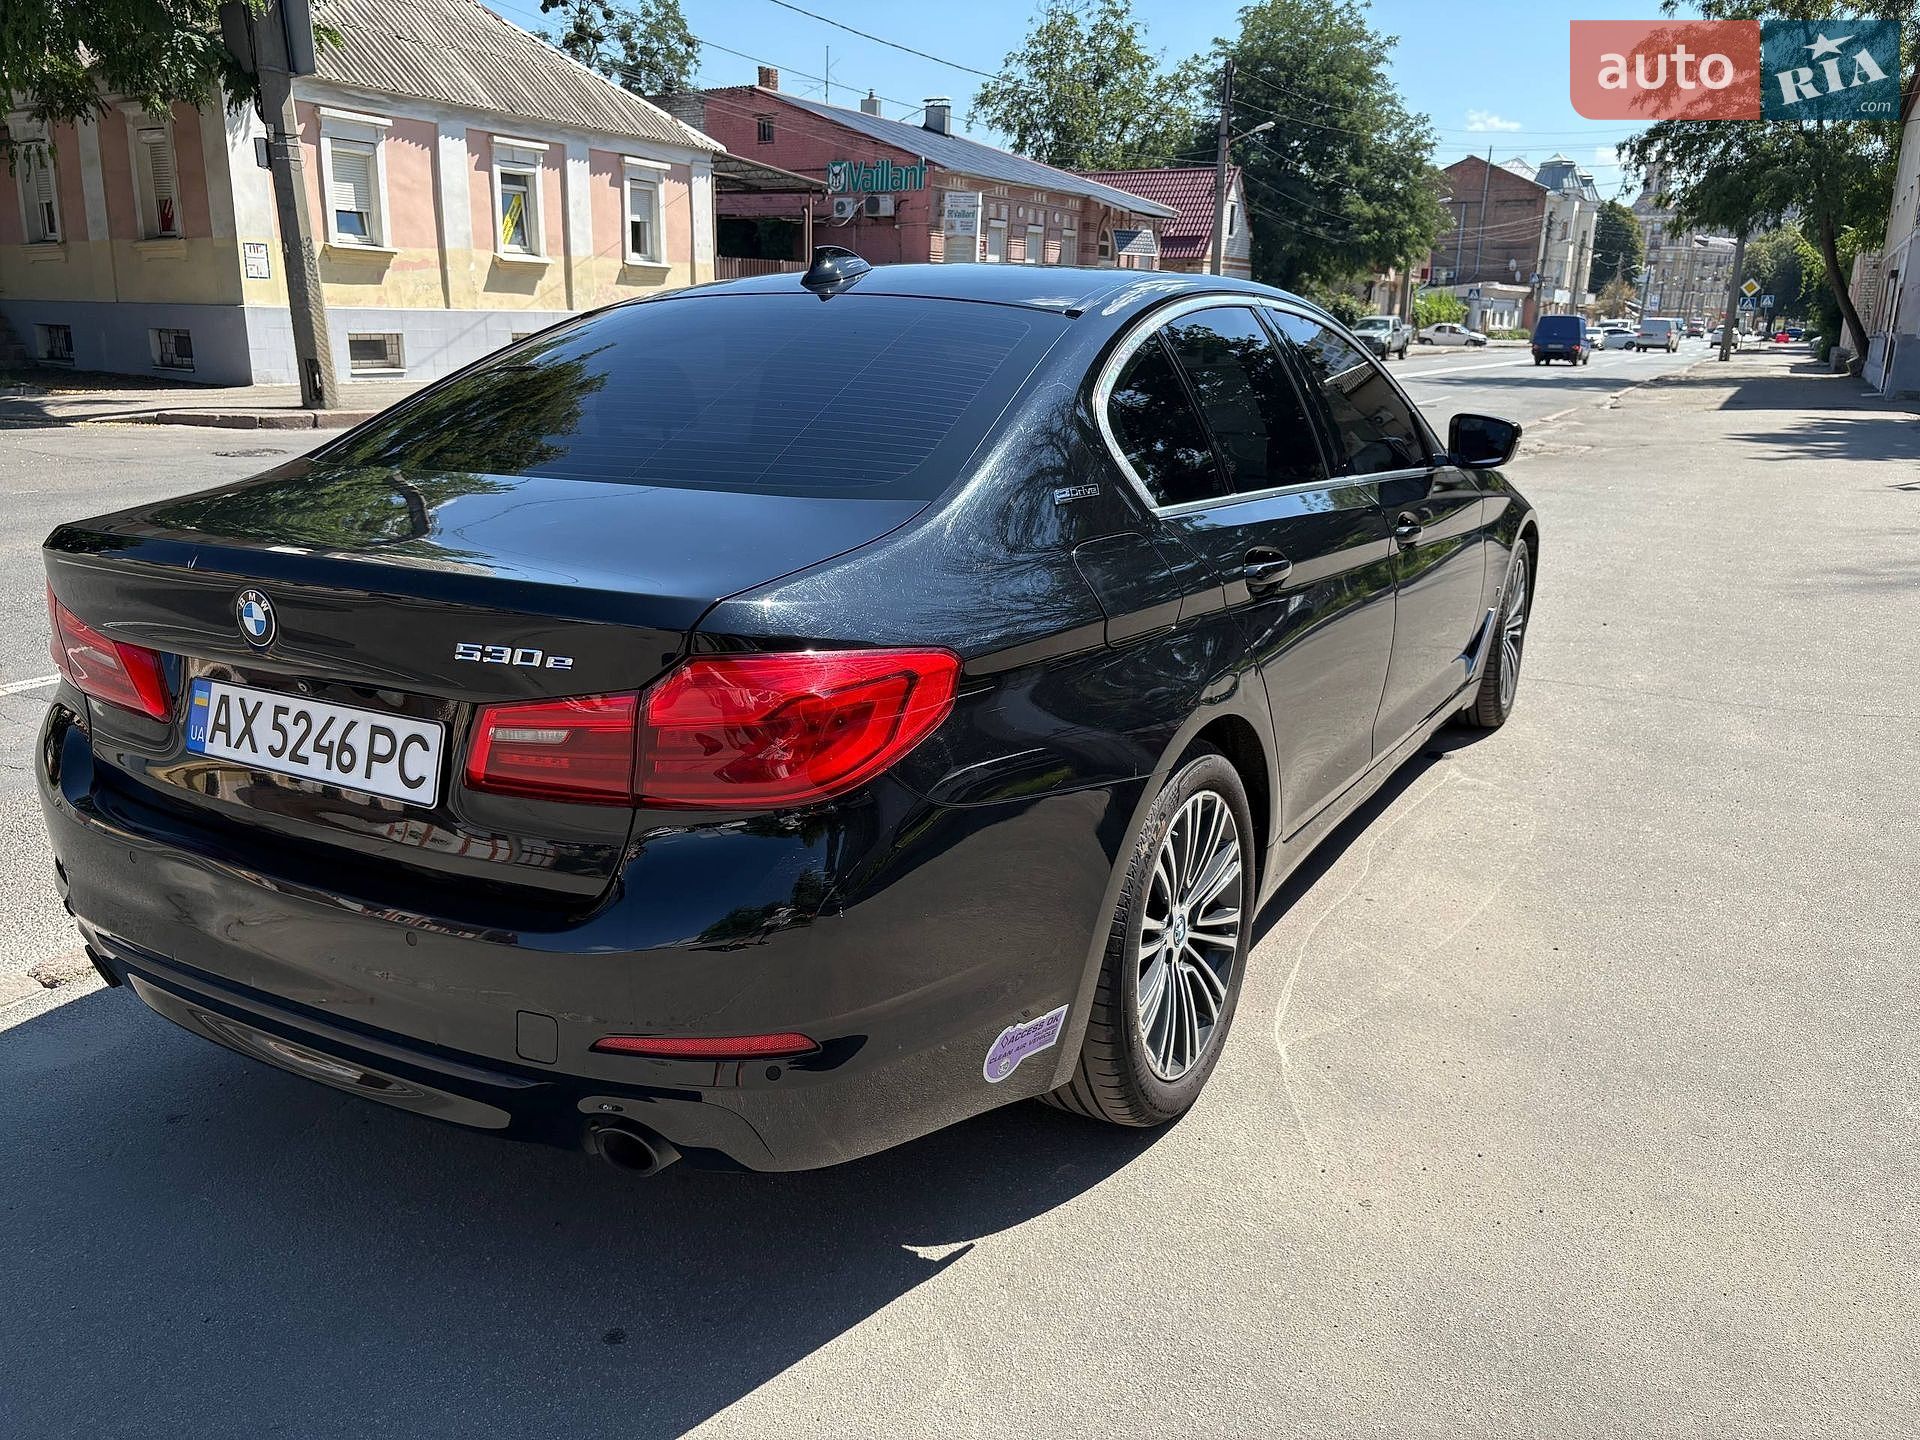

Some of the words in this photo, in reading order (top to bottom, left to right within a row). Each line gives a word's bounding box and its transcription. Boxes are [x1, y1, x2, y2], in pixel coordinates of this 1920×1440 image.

[847, 157, 928, 193] Vaillant
[238, 592, 270, 612] BMW
[454, 642, 574, 670] 530e
[190, 729, 205, 743] UA
[208, 694, 263, 754] AX
[268, 705, 357, 775] 5246
[364, 724, 431, 790] PC
[1007, 1020, 1045, 1046] ACCESS
[1047, 1013, 1062, 1026] OK
[988, 1048, 1014, 1065] CLEAN
